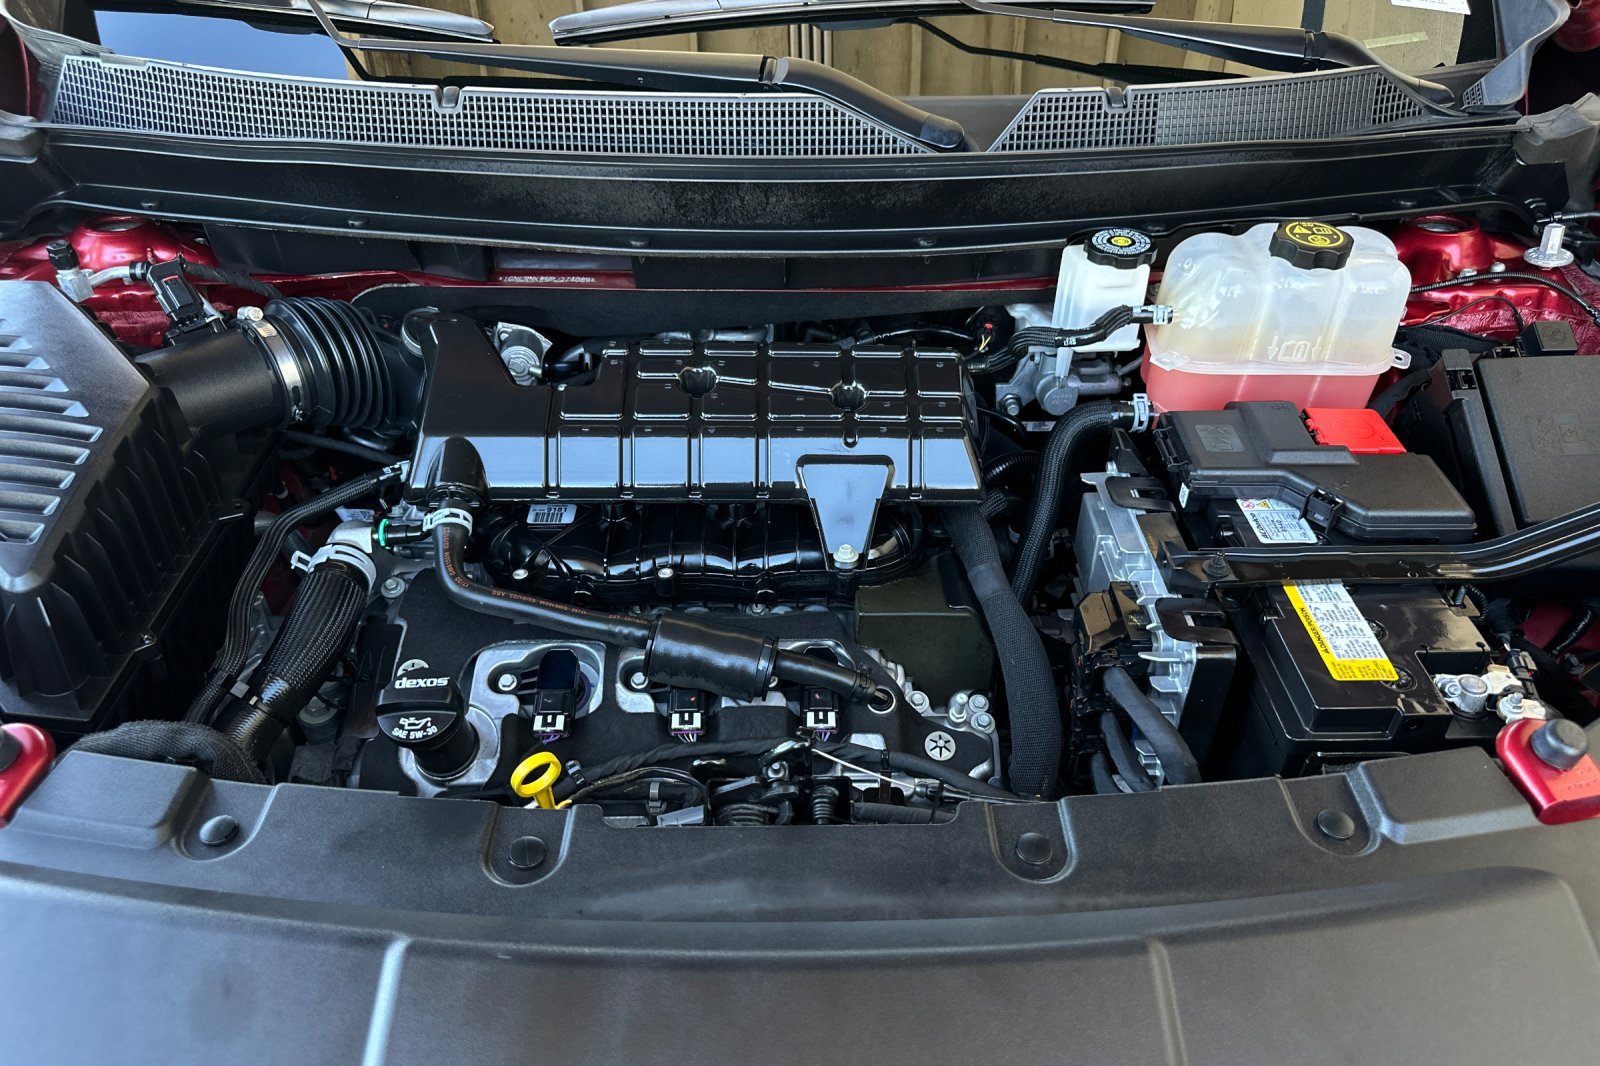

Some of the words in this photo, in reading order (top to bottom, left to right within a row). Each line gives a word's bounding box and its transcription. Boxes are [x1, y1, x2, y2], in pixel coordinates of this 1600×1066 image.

[394, 676, 451, 689] dexos
[392, 727, 408, 739] SAE
[409, 725, 438, 739] 5W-30
